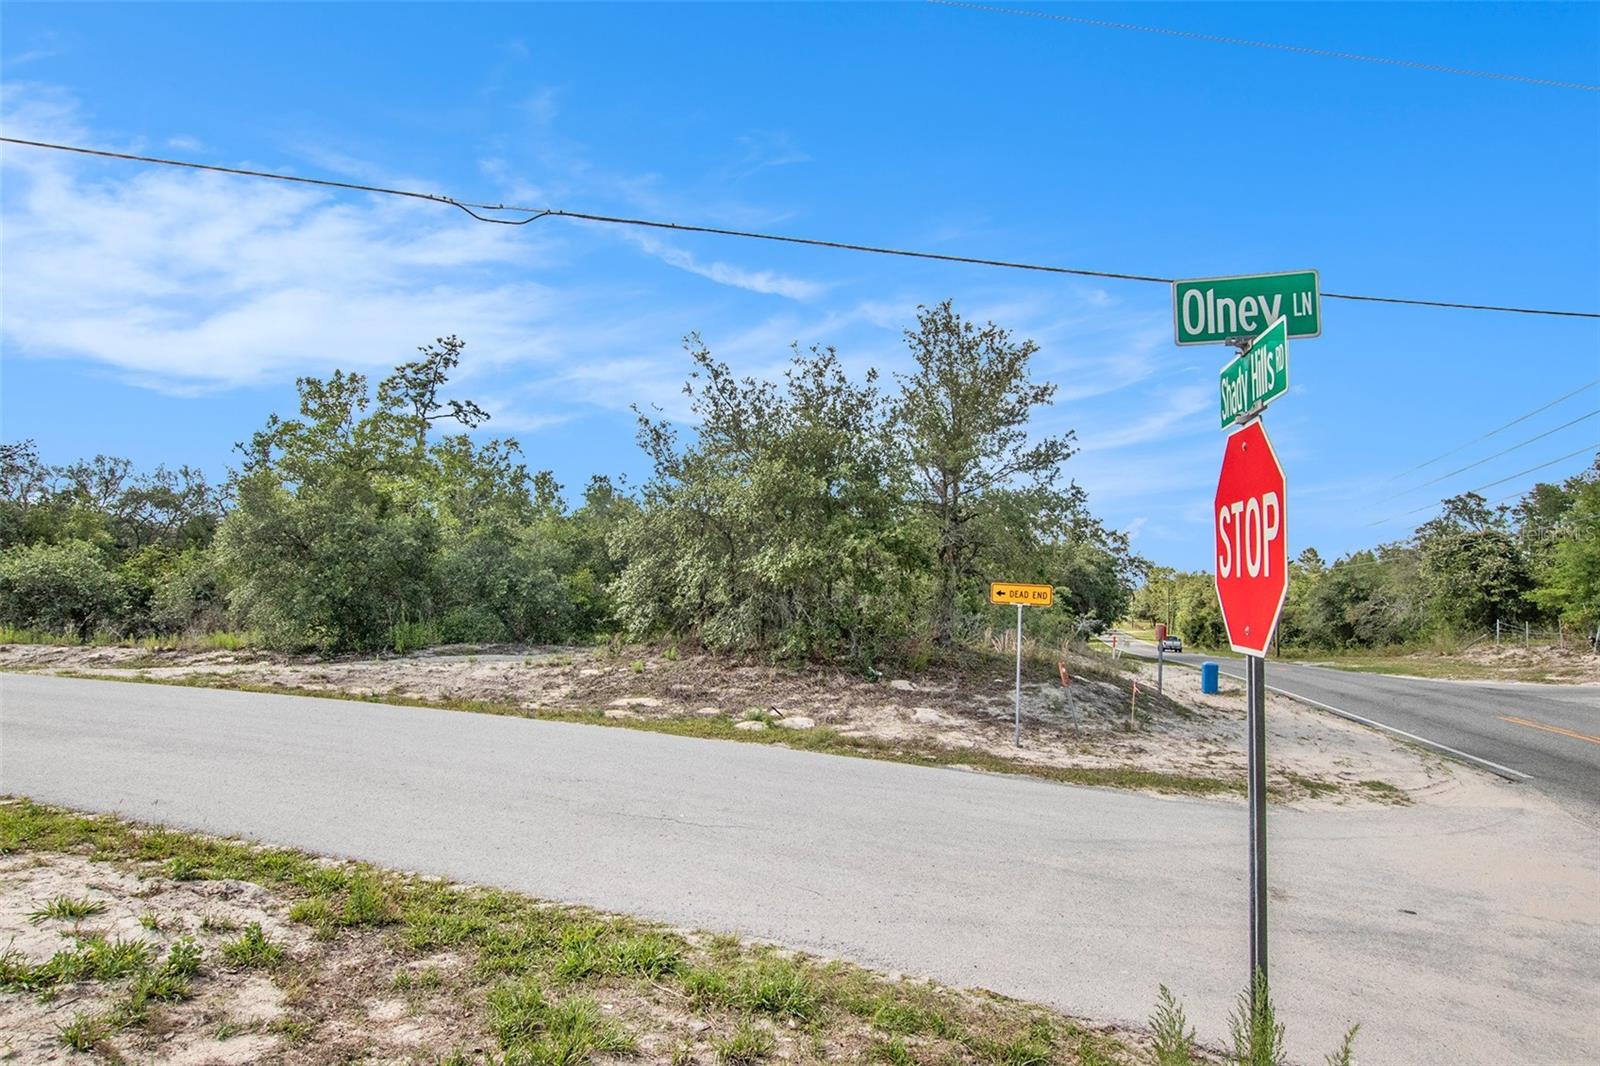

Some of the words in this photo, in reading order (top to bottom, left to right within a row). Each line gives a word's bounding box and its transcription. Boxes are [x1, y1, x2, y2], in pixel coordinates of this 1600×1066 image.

[1182, 288, 1282, 335] Olney
[1292, 291, 1313, 317] LN
[1221, 365, 1248, 420] Shady
[1250, 344, 1275, 401] Hills
[1275, 343, 1285, 373] RD
[1219, 491, 1280, 579] STOP
[1009, 590, 1029, 598] DEAD
[1032, 591, 1048, 600] END
